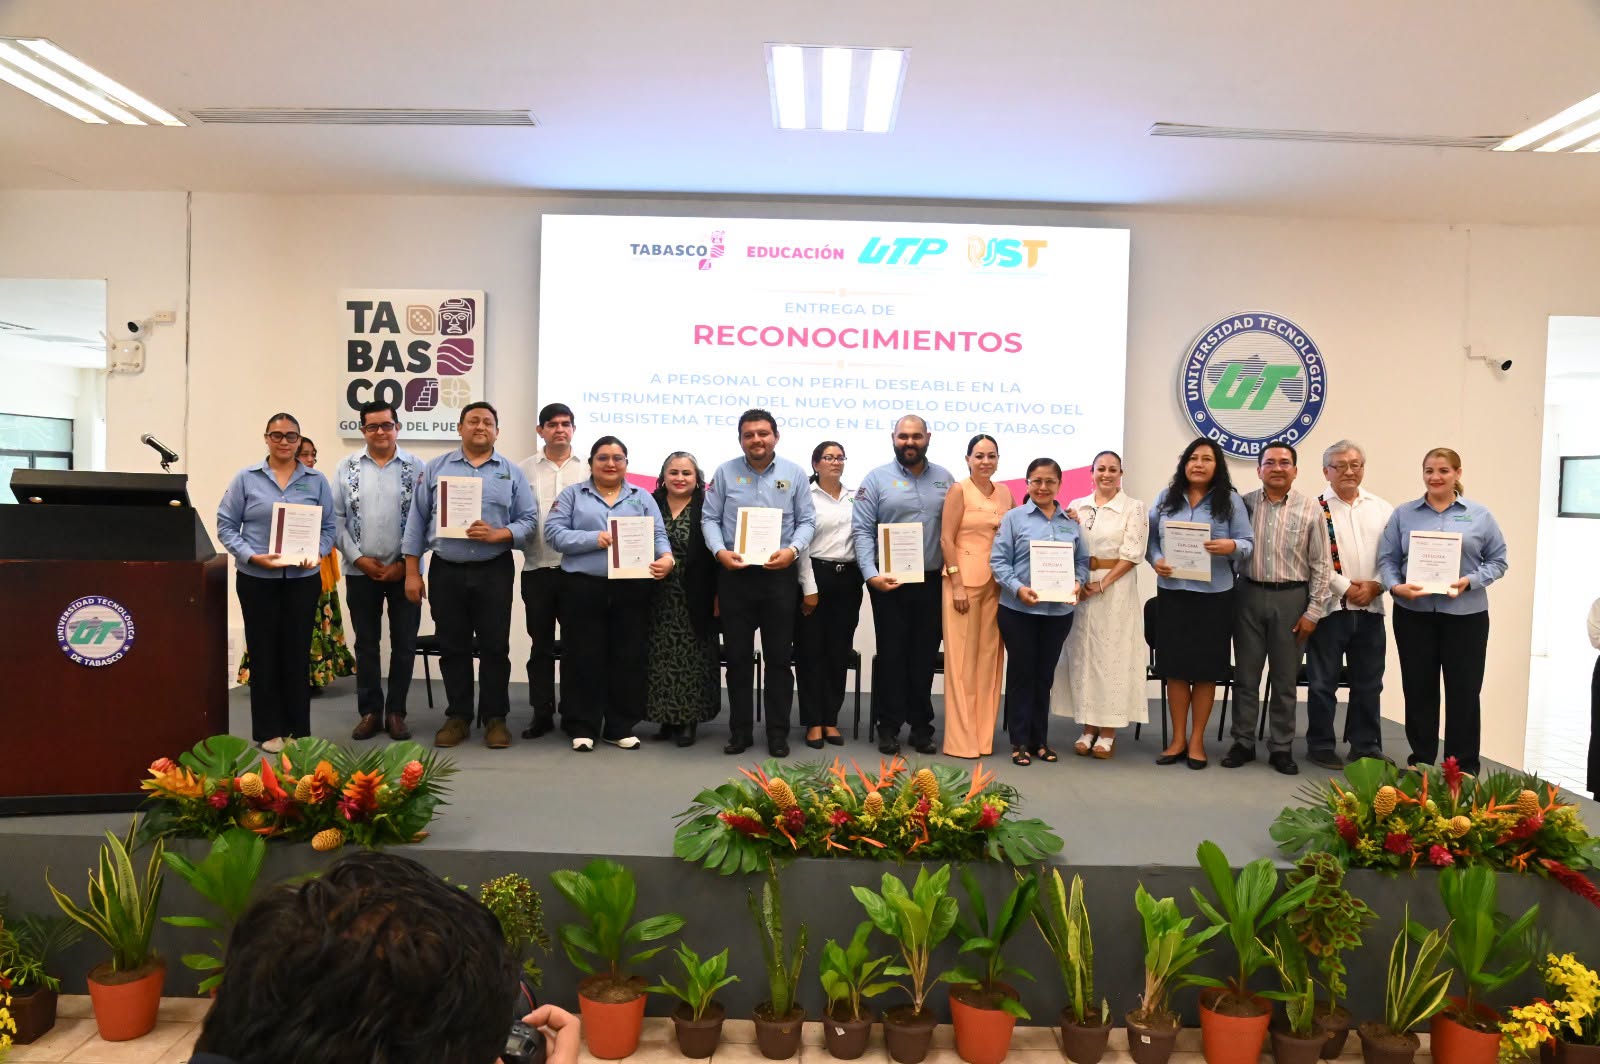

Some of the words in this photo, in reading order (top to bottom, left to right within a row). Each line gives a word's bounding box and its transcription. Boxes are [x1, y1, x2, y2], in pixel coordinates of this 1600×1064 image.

[630, 243, 708, 257] TABASCO
[746, 244, 844, 260] EDUCACIÓN
[346, 300, 401, 334] TA
[784, 302, 866, 315] ENTREGA
[871, 304, 895, 316] DE
[693, 324, 1023, 353] RECONOCIMIENTOS
[347, 340, 432, 374] BAS
[1188, 317, 1254, 401] UNIVERSIDAD
[1259, 317, 1322, 403] TECNOLÓGICA
[650, 373, 662, 384] A
[667, 373, 760, 387] PERSONAL
[766, 376, 804, 388] CON
[810, 377, 869, 390] PERFIL
[875, 378, 965, 393] DESEABLE
[971, 381, 994, 393] EN
[1000, 382, 1022, 394] LA
[346, 378, 404, 412] CO
[756, 396, 788, 408] DEL
[795, 397, 857, 409] NUEVO
[862, 399, 939, 412] MODELO
[944, 401, 1046, 414] EDUCATIVO
[1050, 404, 1084, 416] DEL
[406, 421, 429, 432] DEL
[589, 412, 699, 425] SUBSISTEMA
[704, 414, 830, 429] TECOGICO
[835, 418, 859, 430] EN
[864, 419, 885, 430] EL
[965, 421, 989, 433] DE
[994, 422, 1076, 436] TABASCO
[1208, 427, 1229, 448] DE
[57, 598, 95, 641] UNIVERSIDAD
[70, 653, 83, 664] DE
[84, 652, 123, 667] TABASCO
